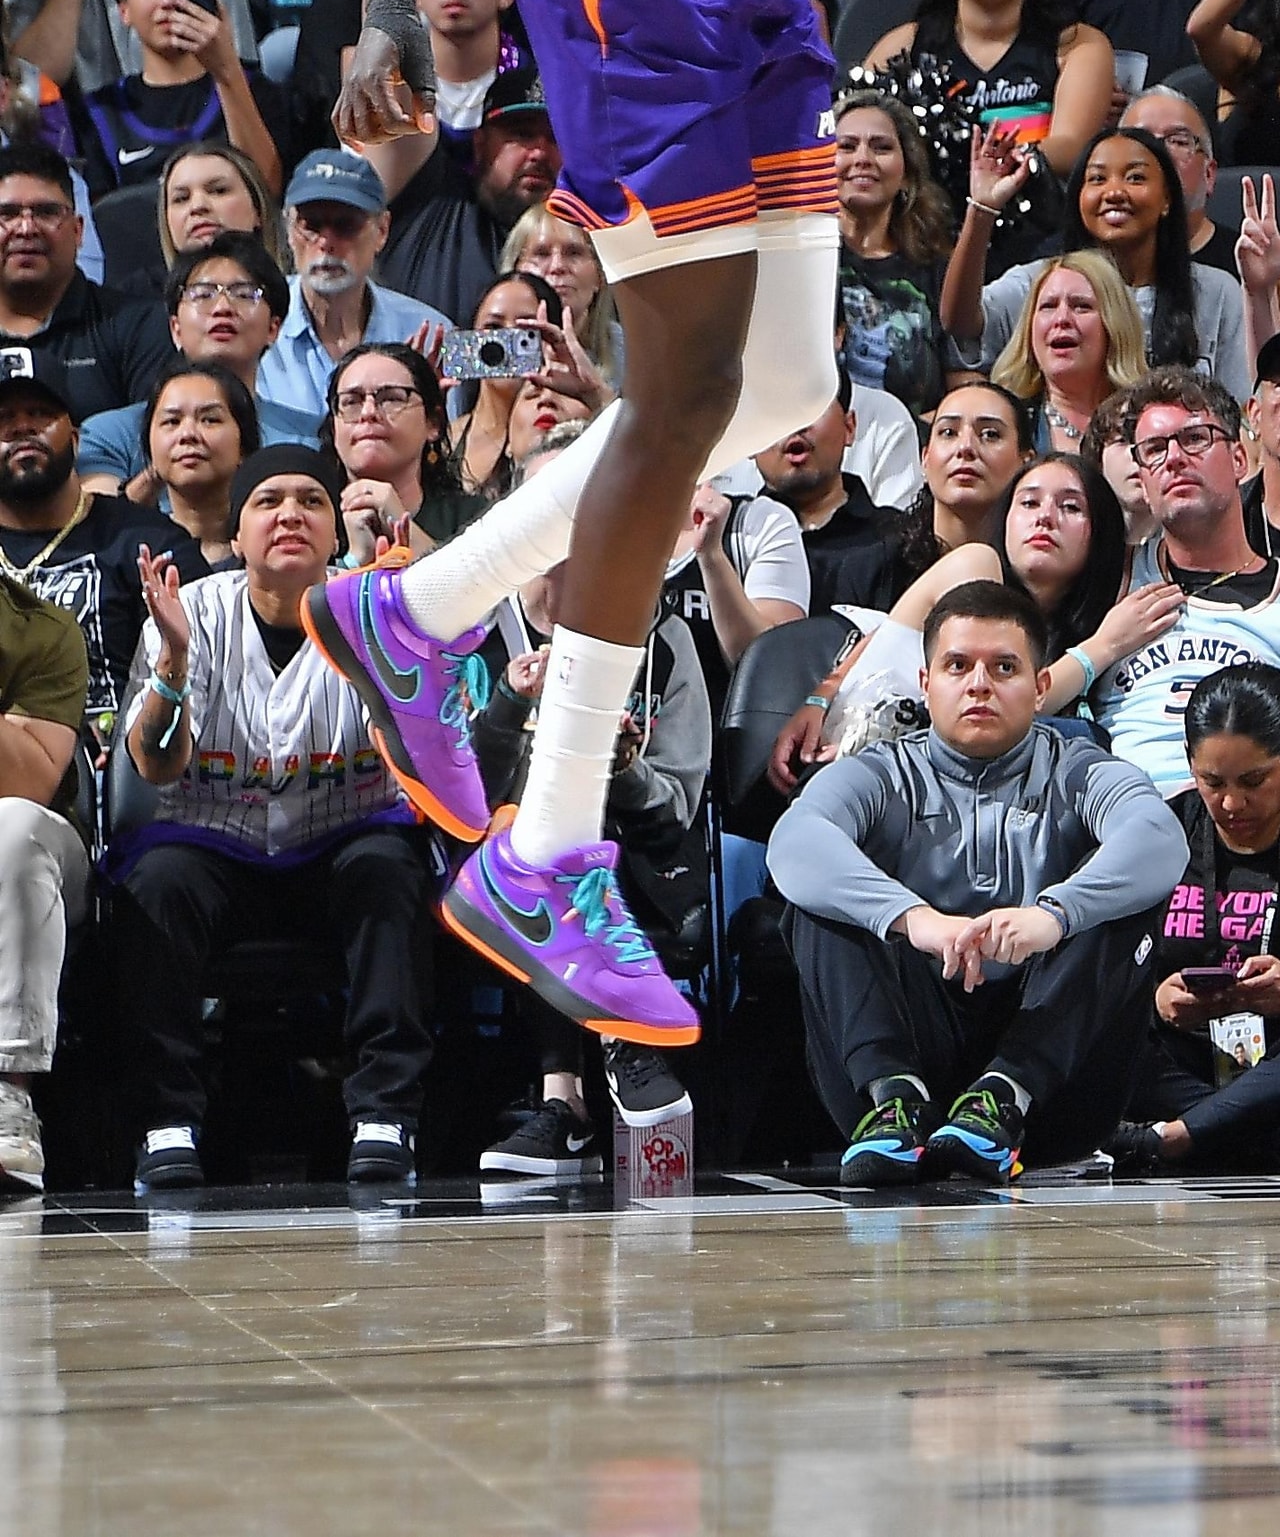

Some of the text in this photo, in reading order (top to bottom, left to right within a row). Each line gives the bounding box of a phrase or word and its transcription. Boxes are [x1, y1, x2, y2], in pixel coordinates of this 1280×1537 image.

[965, 75, 1042, 109] Antonio
[1115, 638, 1256, 693] SAN ANTO
[1163, 911, 1264, 942] HE GA
